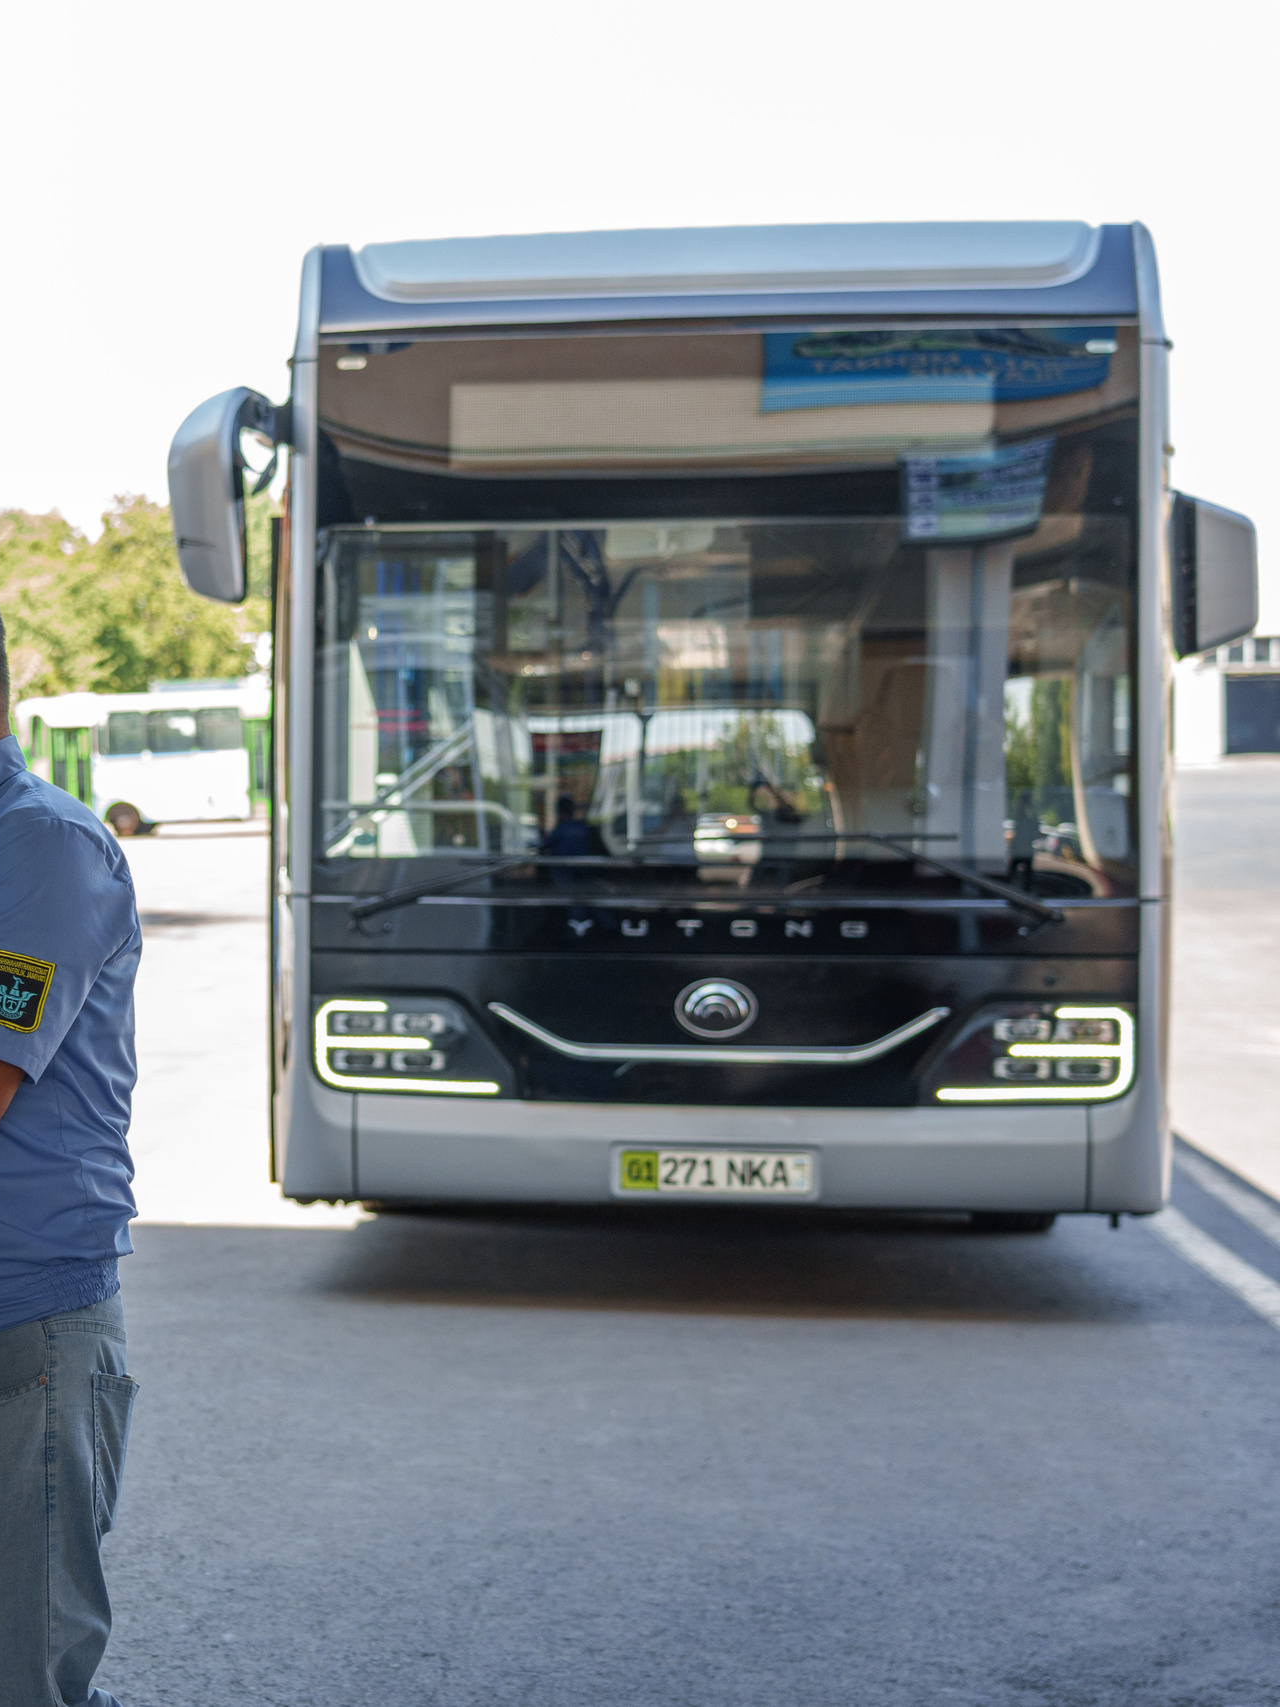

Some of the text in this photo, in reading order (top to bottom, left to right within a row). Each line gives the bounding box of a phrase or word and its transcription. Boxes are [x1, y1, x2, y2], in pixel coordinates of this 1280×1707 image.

[568, 919, 868, 938] YUTONG
[662, 1158, 715, 1186] 271
[727, 1159, 789, 1187] NKA
